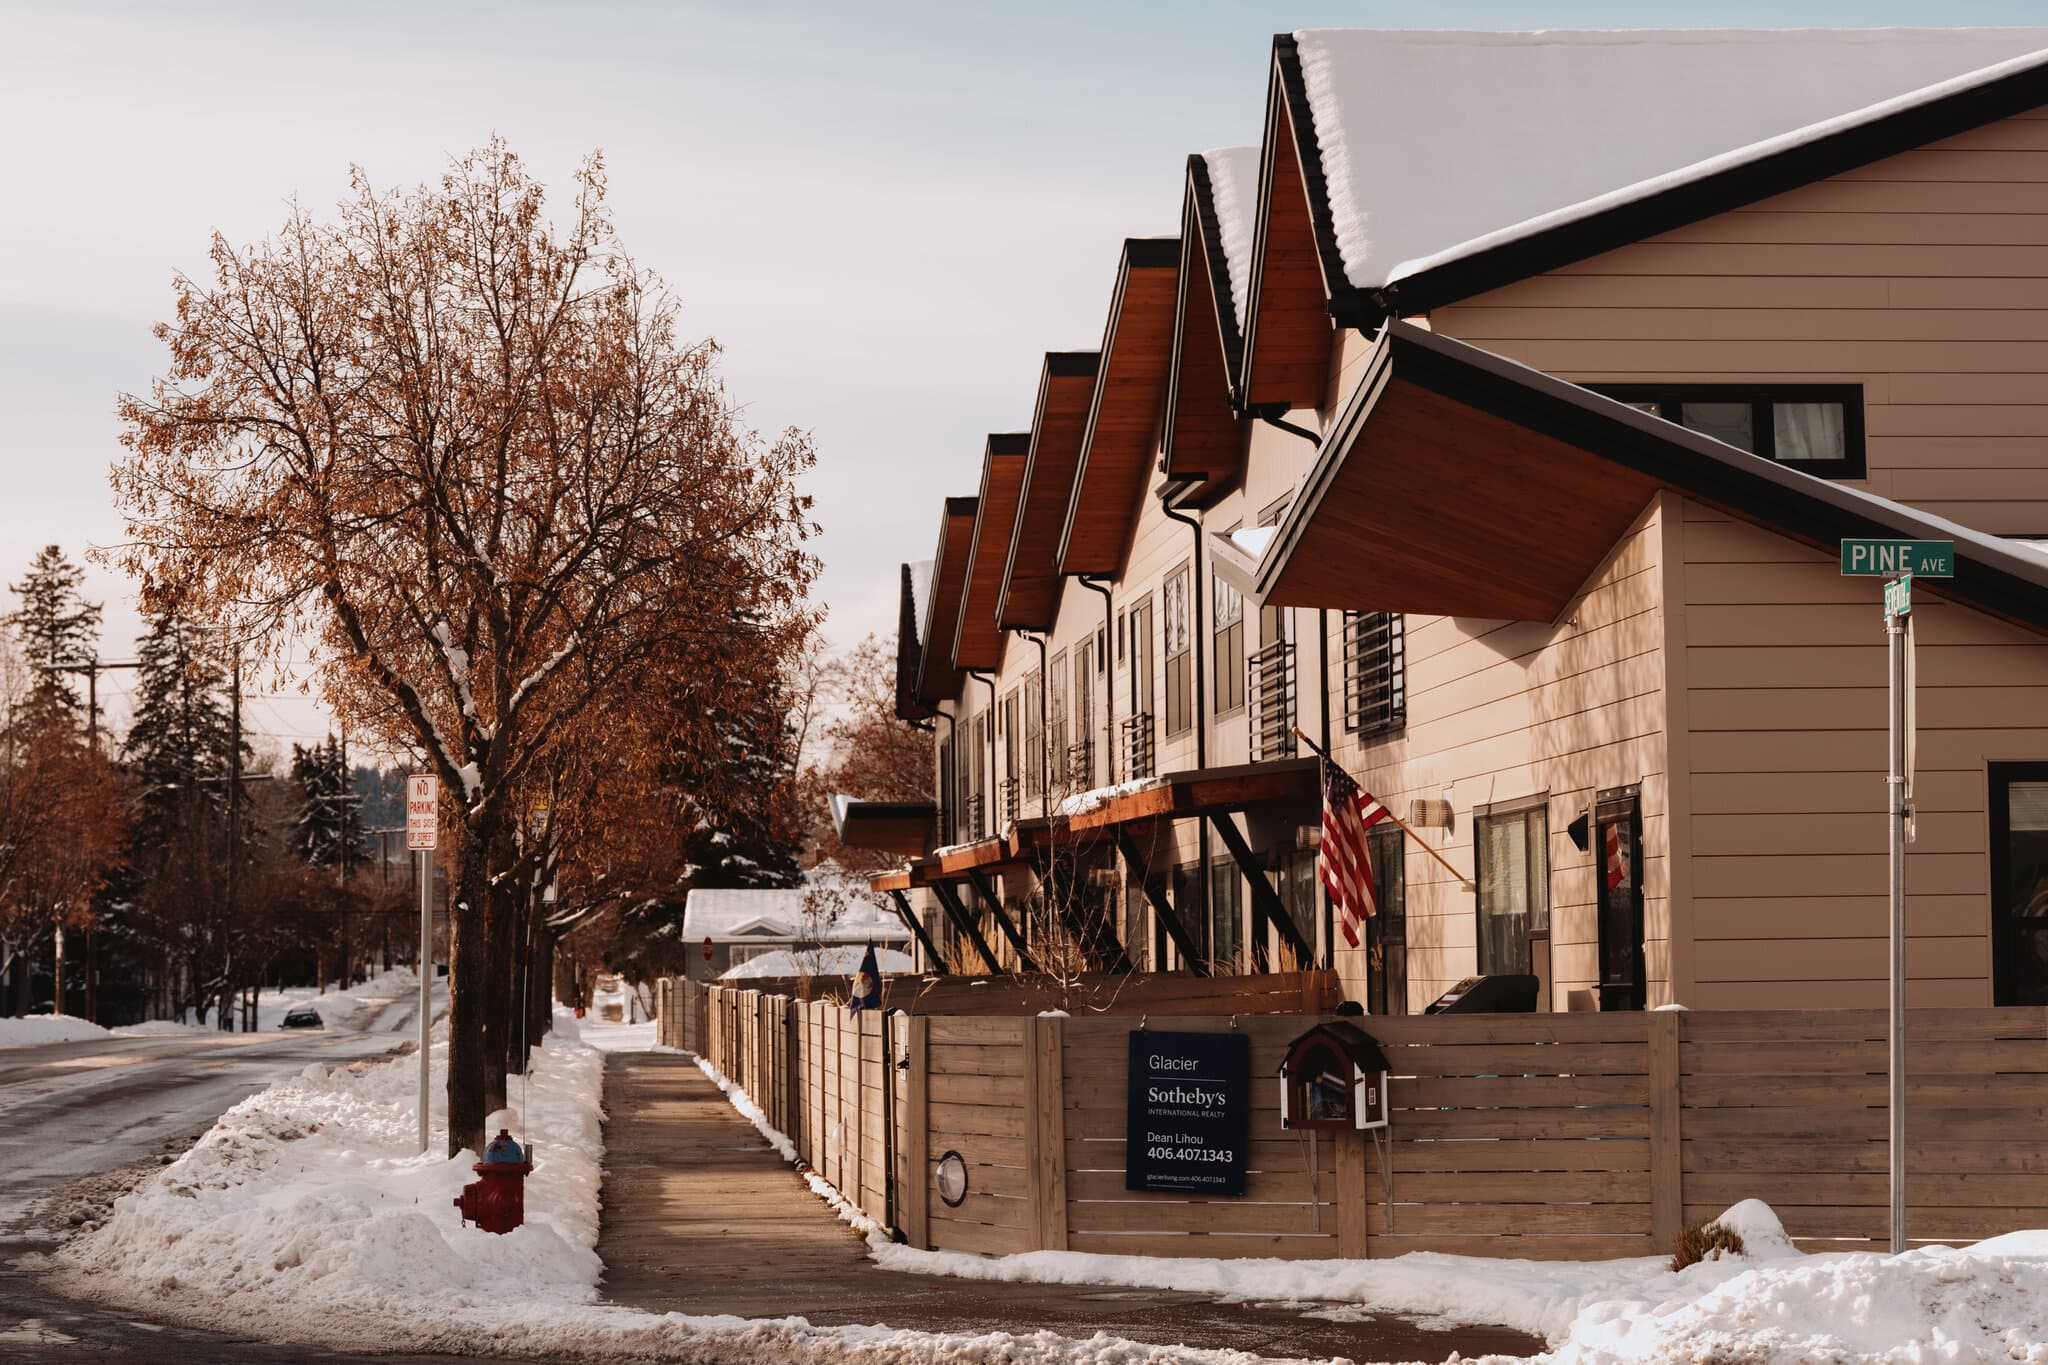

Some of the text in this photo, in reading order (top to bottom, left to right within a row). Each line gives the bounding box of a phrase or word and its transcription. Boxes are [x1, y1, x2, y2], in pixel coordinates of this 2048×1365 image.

[1852, 544, 1946, 572] PINE AVE
[416, 782, 429, 796] NO
[410, 801, 435, 814] PARKING
[410, 819, 434, 828] THIS SIDE
[409, 832, 434, 842] OF STREET
[1149, 1054, 1199, 1071] Glacier
[1148, 1086, 1226, 1108] Sotheby's
[1148, 1108, 1200, 1117] INTERNATIONAL
[1147, 1132, 1204, 1145] Dean Lihou
[1147, 1147, 1233, 1163] 406.407.1343
